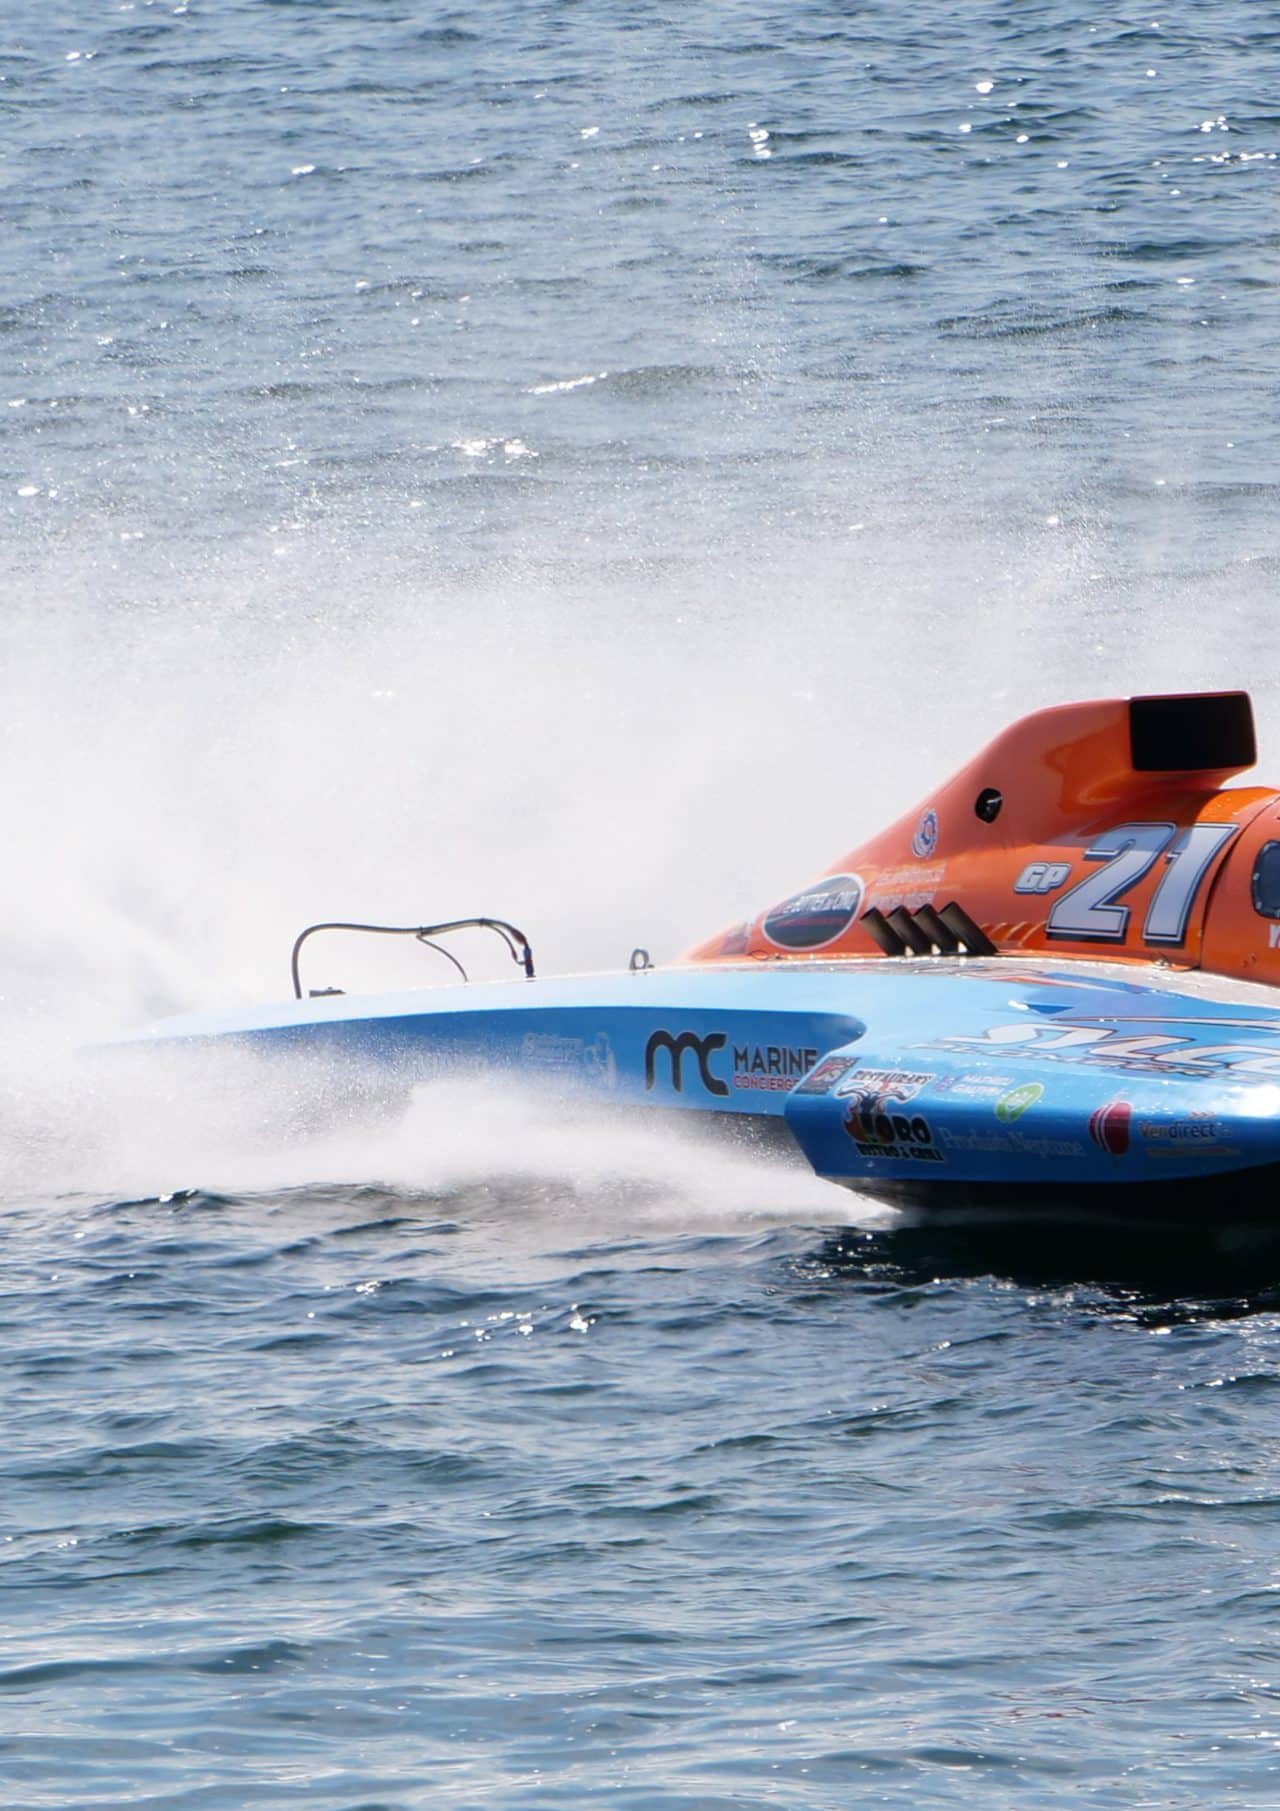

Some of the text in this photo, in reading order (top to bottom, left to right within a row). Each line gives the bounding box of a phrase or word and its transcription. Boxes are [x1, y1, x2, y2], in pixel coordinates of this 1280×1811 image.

[1014, 822, 1239, 946] GP 21
[733, 1045, 818, 1076] MARINE
